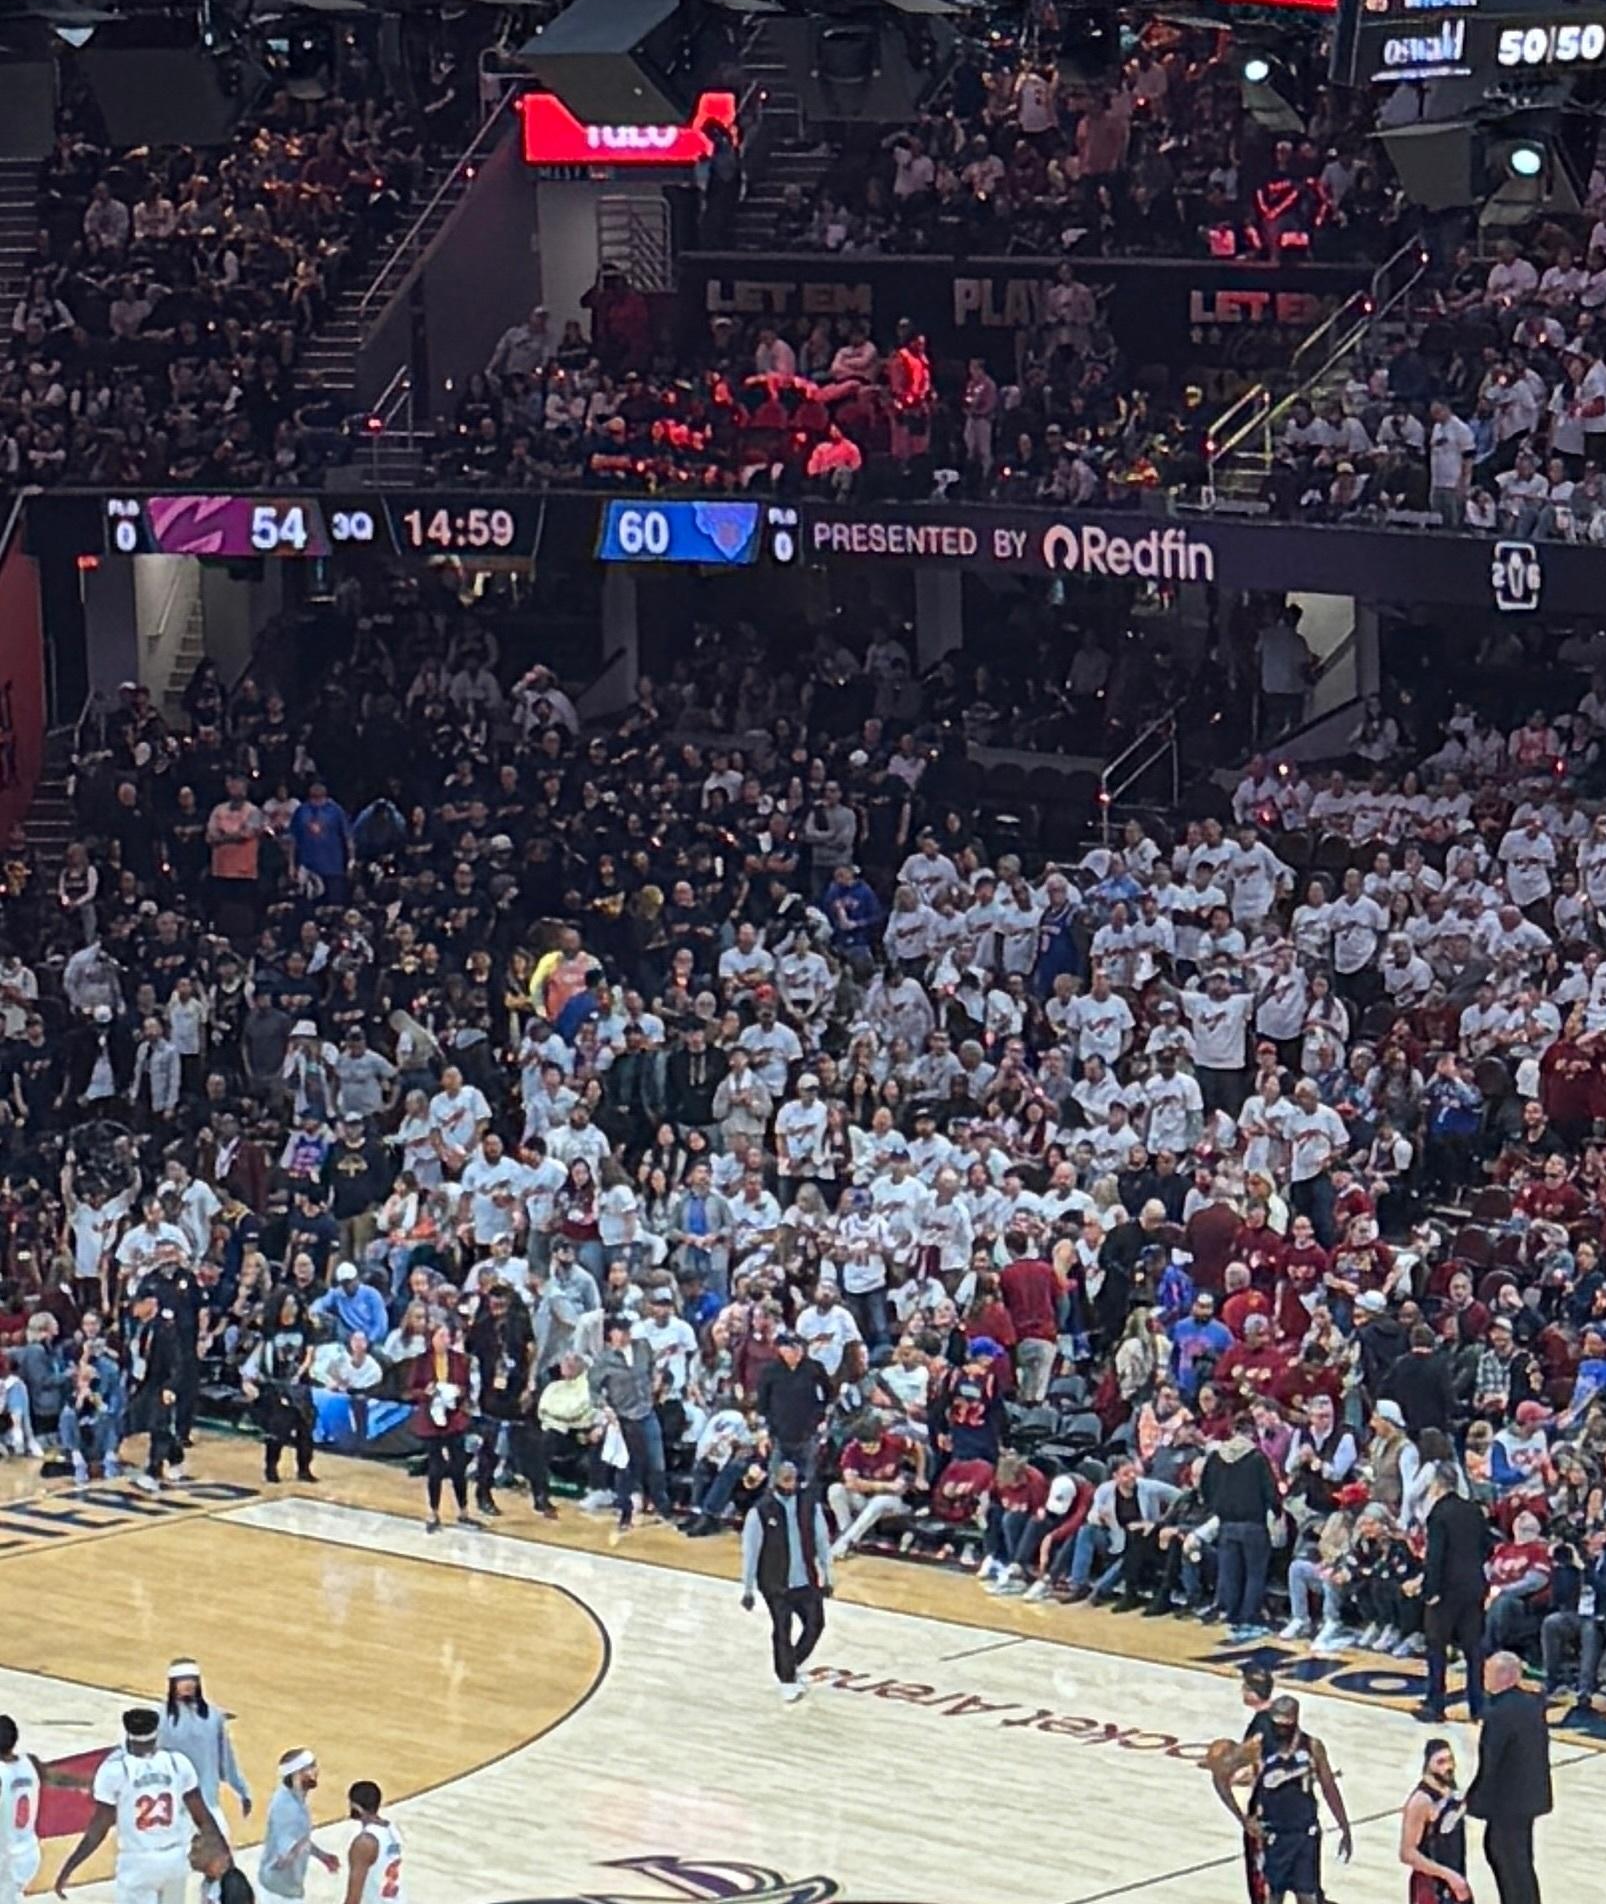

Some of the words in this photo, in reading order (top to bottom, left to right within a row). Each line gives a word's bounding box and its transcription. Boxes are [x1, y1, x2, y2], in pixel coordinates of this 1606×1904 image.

[116, 521, 137, 553] 0
[251, 506, 307, 549] 54
[403, 508, 514, 548] 14:59
[618, 506, 669, 553] 60
[773, 531, 793, 562] 0
[813, 522, 977, 557] PRESENTED
[994, 528, 1026, 560] BY
[1080, 526, 1213, 583] Redfin
[134, 1792, 174, 1832] 23
